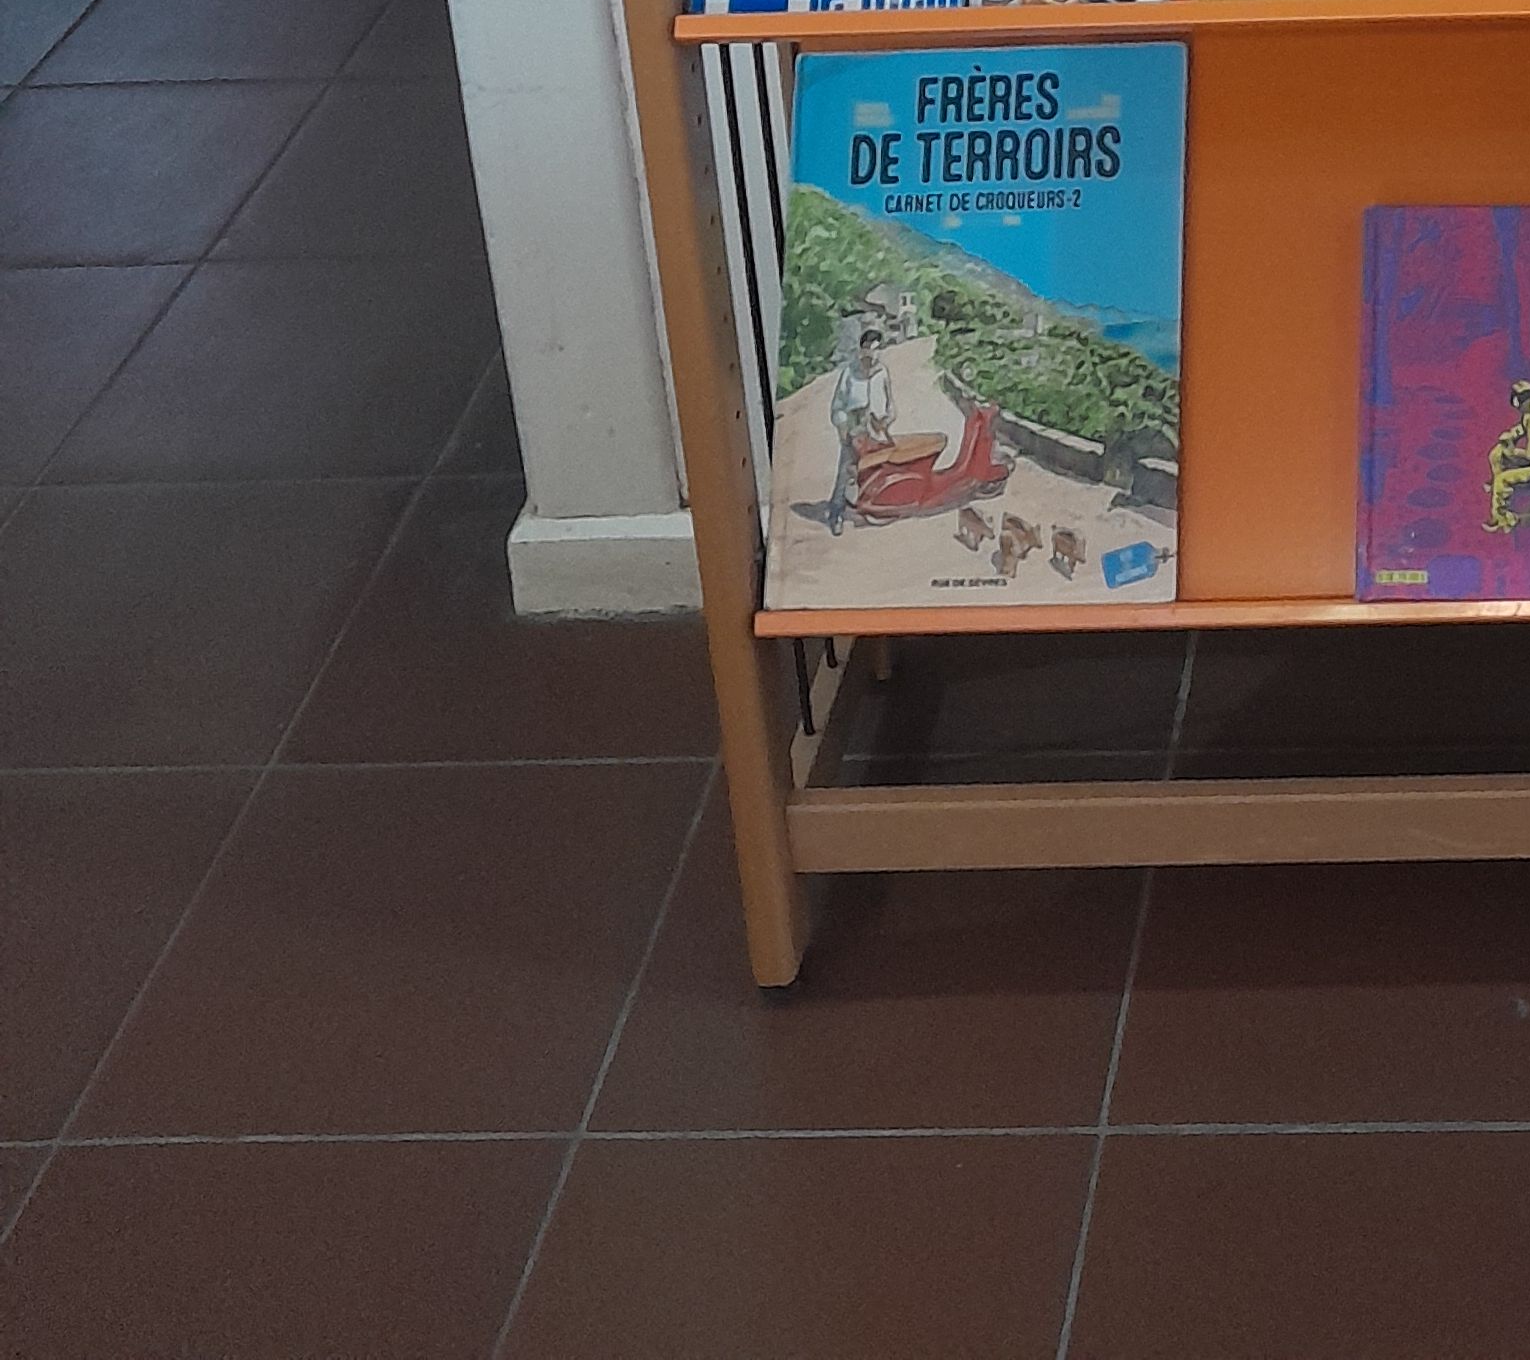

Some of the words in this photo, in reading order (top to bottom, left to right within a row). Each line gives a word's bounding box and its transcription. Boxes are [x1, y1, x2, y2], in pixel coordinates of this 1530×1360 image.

[916, 64, 1061, 124] FRÈRES
[849, 131, 902, 187] DE
[916, 125, 1122, 183] TERROIRS
[884, 193, 942, 213] CARNET
[948, 193, 971, 212] DE
[975, 189, 1082, 212] CROQUEURS-2
